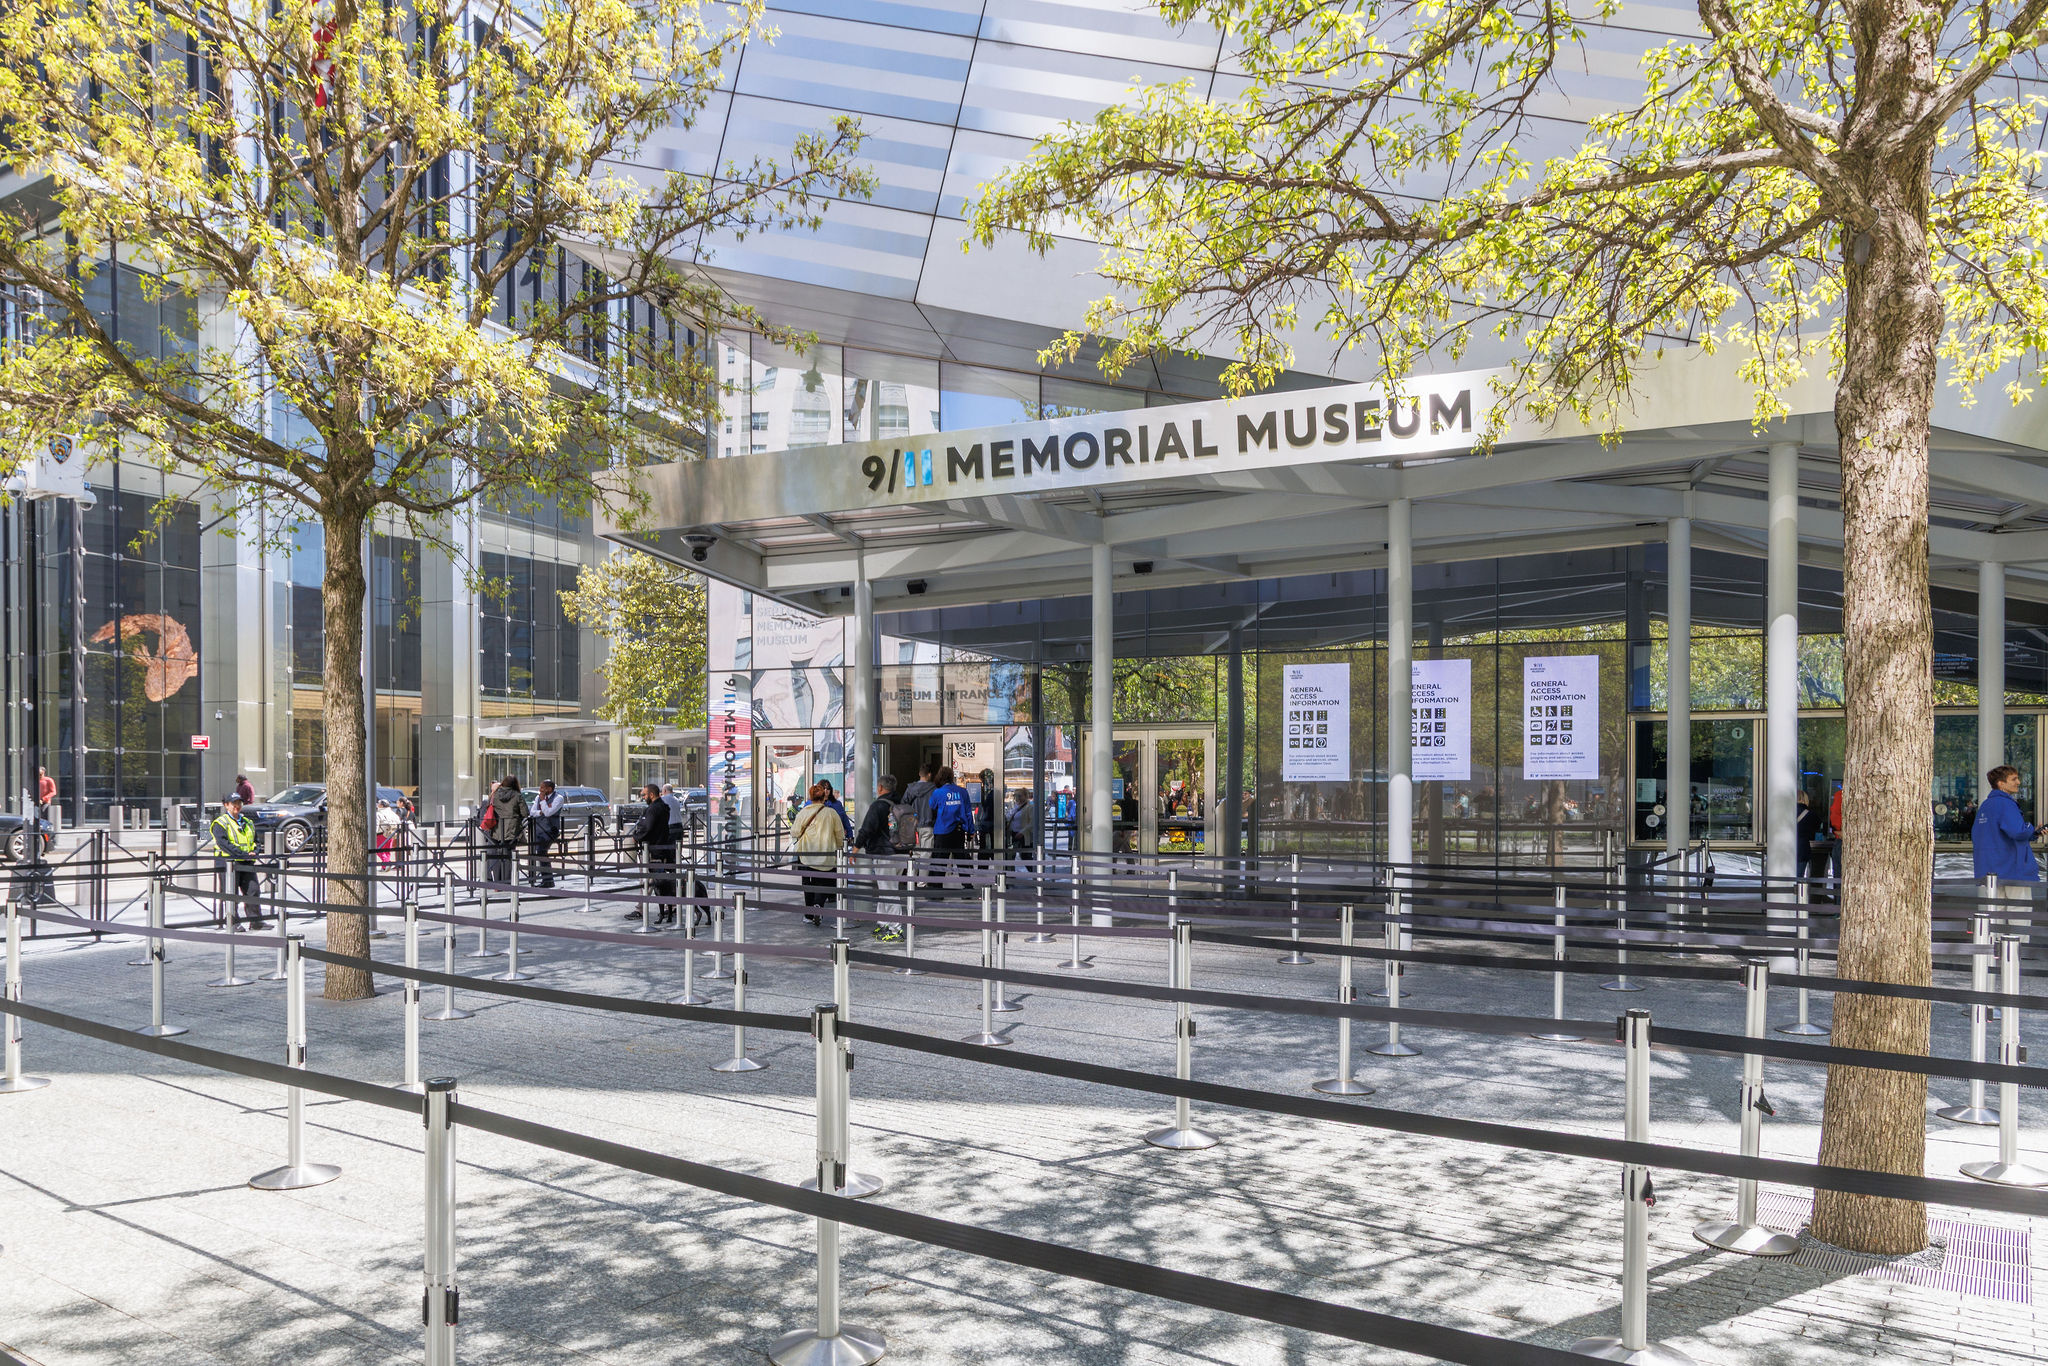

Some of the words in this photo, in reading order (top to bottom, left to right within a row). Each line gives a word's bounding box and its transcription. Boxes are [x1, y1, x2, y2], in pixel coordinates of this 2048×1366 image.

[861, 448, 933, 494] 9/11
[946, 419, 1219, 483] MEMORIAL
[1236, 389, 1472, 454] MUSEUM
[757, 634, 808, 647] MUSEUM
[723, 678, 737, 704] 9/11
[880, 690, 932, 702] MUSEUM
[935, 688, 1004, 701] ENTRANCE
[2017, 725, 2024, 733] 3
[724, 709, 736, 801] MEMORIAL
[946, 792, 960, 800] 9/11
